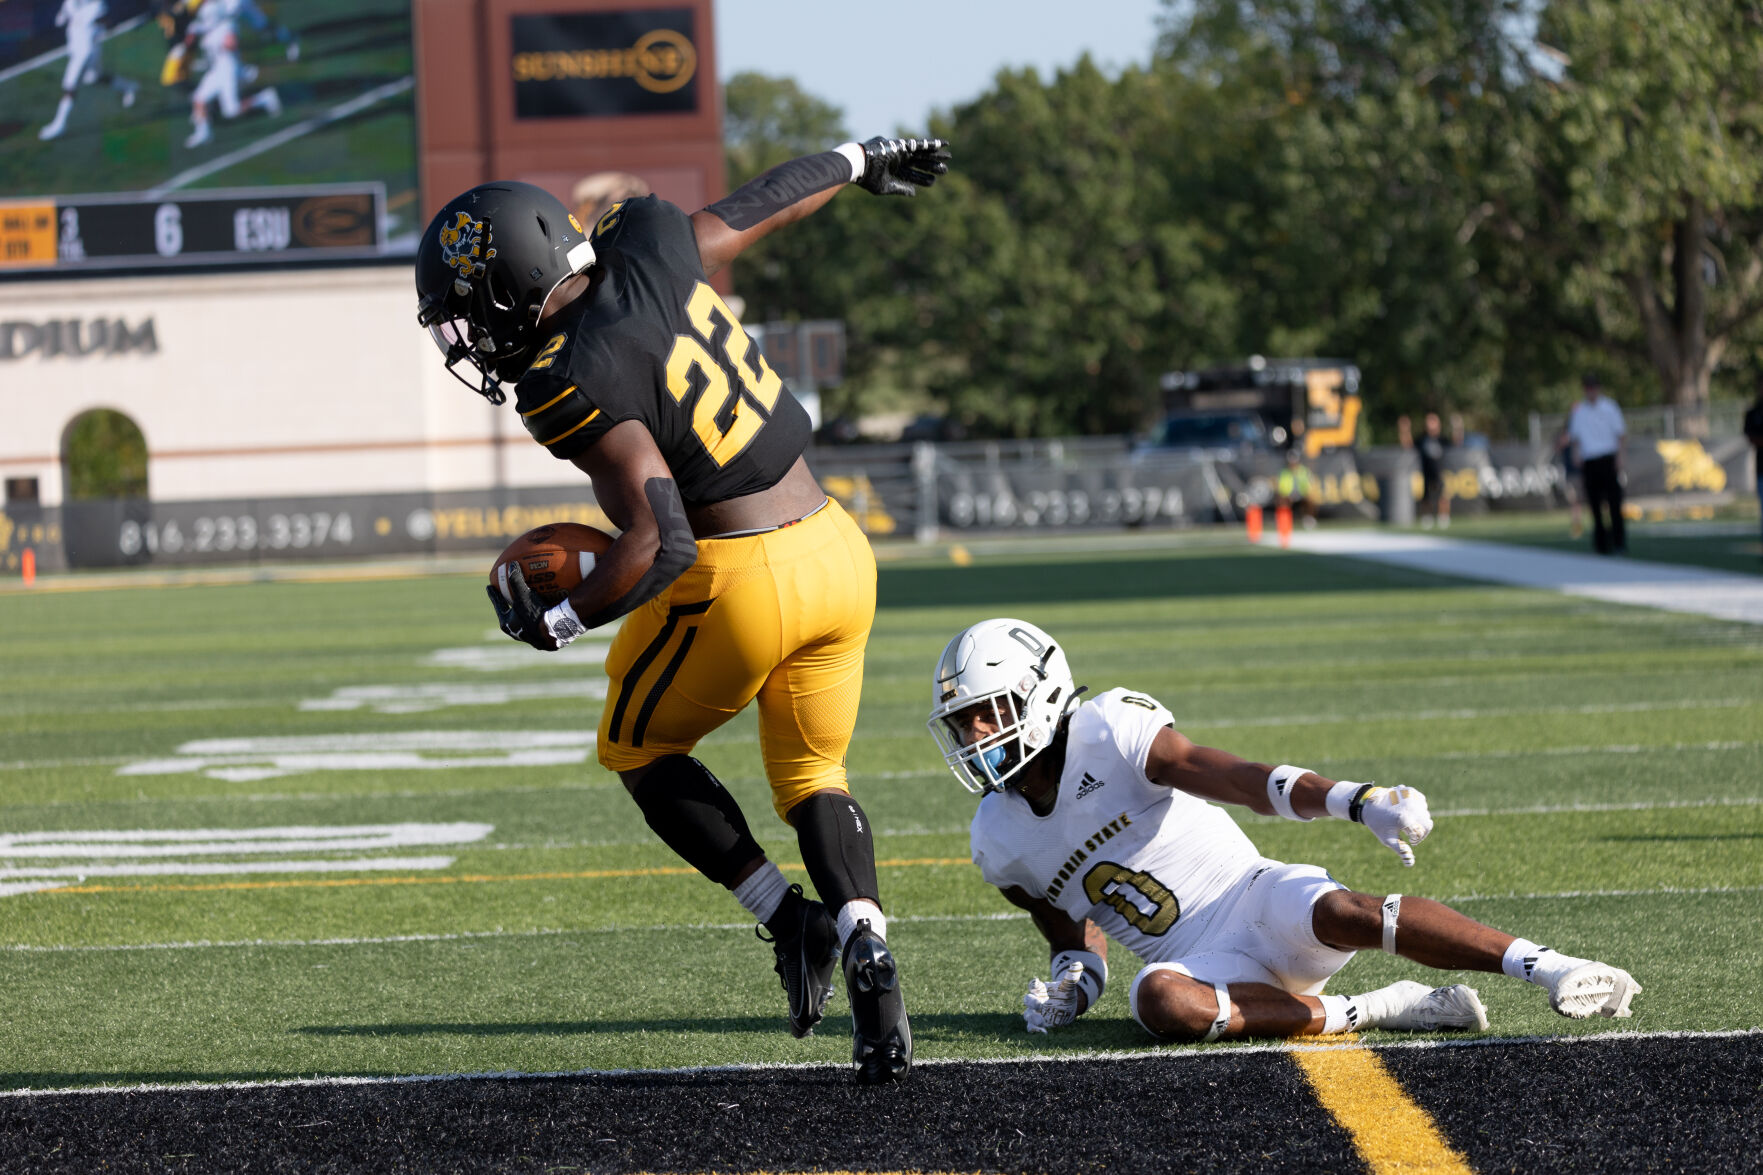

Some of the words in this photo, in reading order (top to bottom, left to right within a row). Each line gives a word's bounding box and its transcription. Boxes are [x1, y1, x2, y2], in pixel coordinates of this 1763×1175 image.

[154, 203, 184, 258] 6
[234, 206, 291, 250] ESU
[663, 279, 783, 470] 22
[1076, 780, 1105, 801] adidas
[1083, 811, 1133, 853] STATE
[1081, 860, 1181, 937] 0
